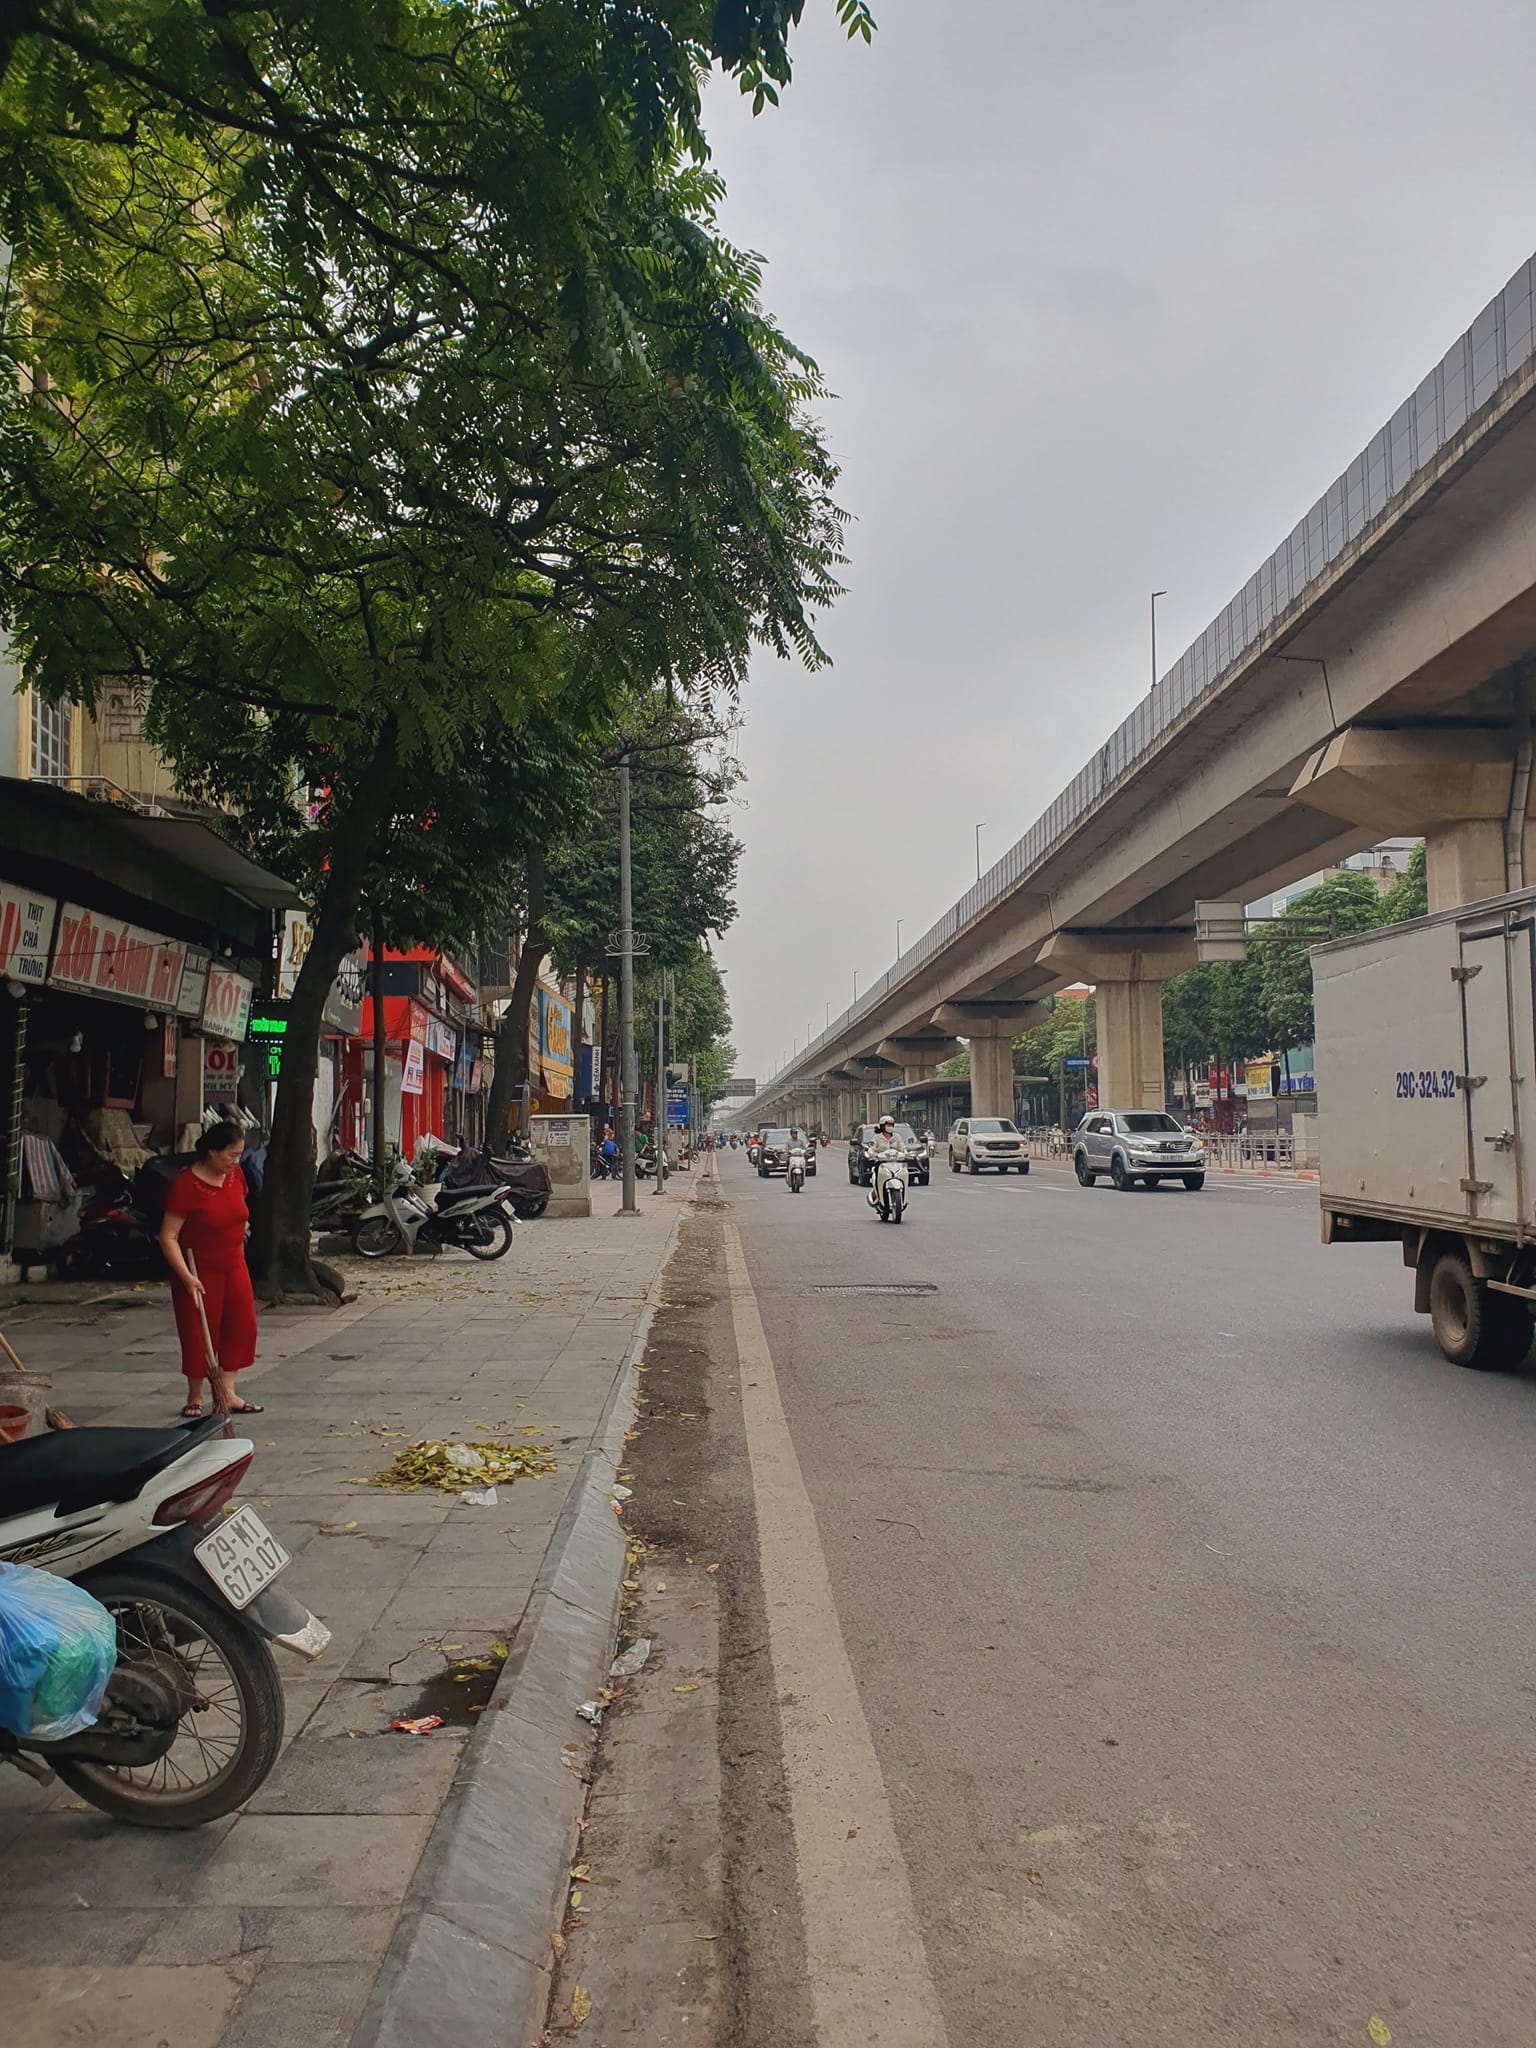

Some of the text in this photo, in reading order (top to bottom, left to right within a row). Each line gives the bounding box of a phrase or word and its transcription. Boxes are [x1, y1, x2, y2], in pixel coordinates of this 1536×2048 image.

[28, 902, 45, 925] THỊT
[23, 926, 39, 949] CHẢ
[54, 911, 99, 983] XÔI
[96, 925, 154, 997] BÁNH
[205, 973, 241, 1021] XÔI
[205, 1043, 235, 1070] ÔI
[1396, 1070, 1455, 1099] 29C-324.32
[207, 1514, 260, 1570] 29-M1
[223, 1536, 283, 1601] 673.07
